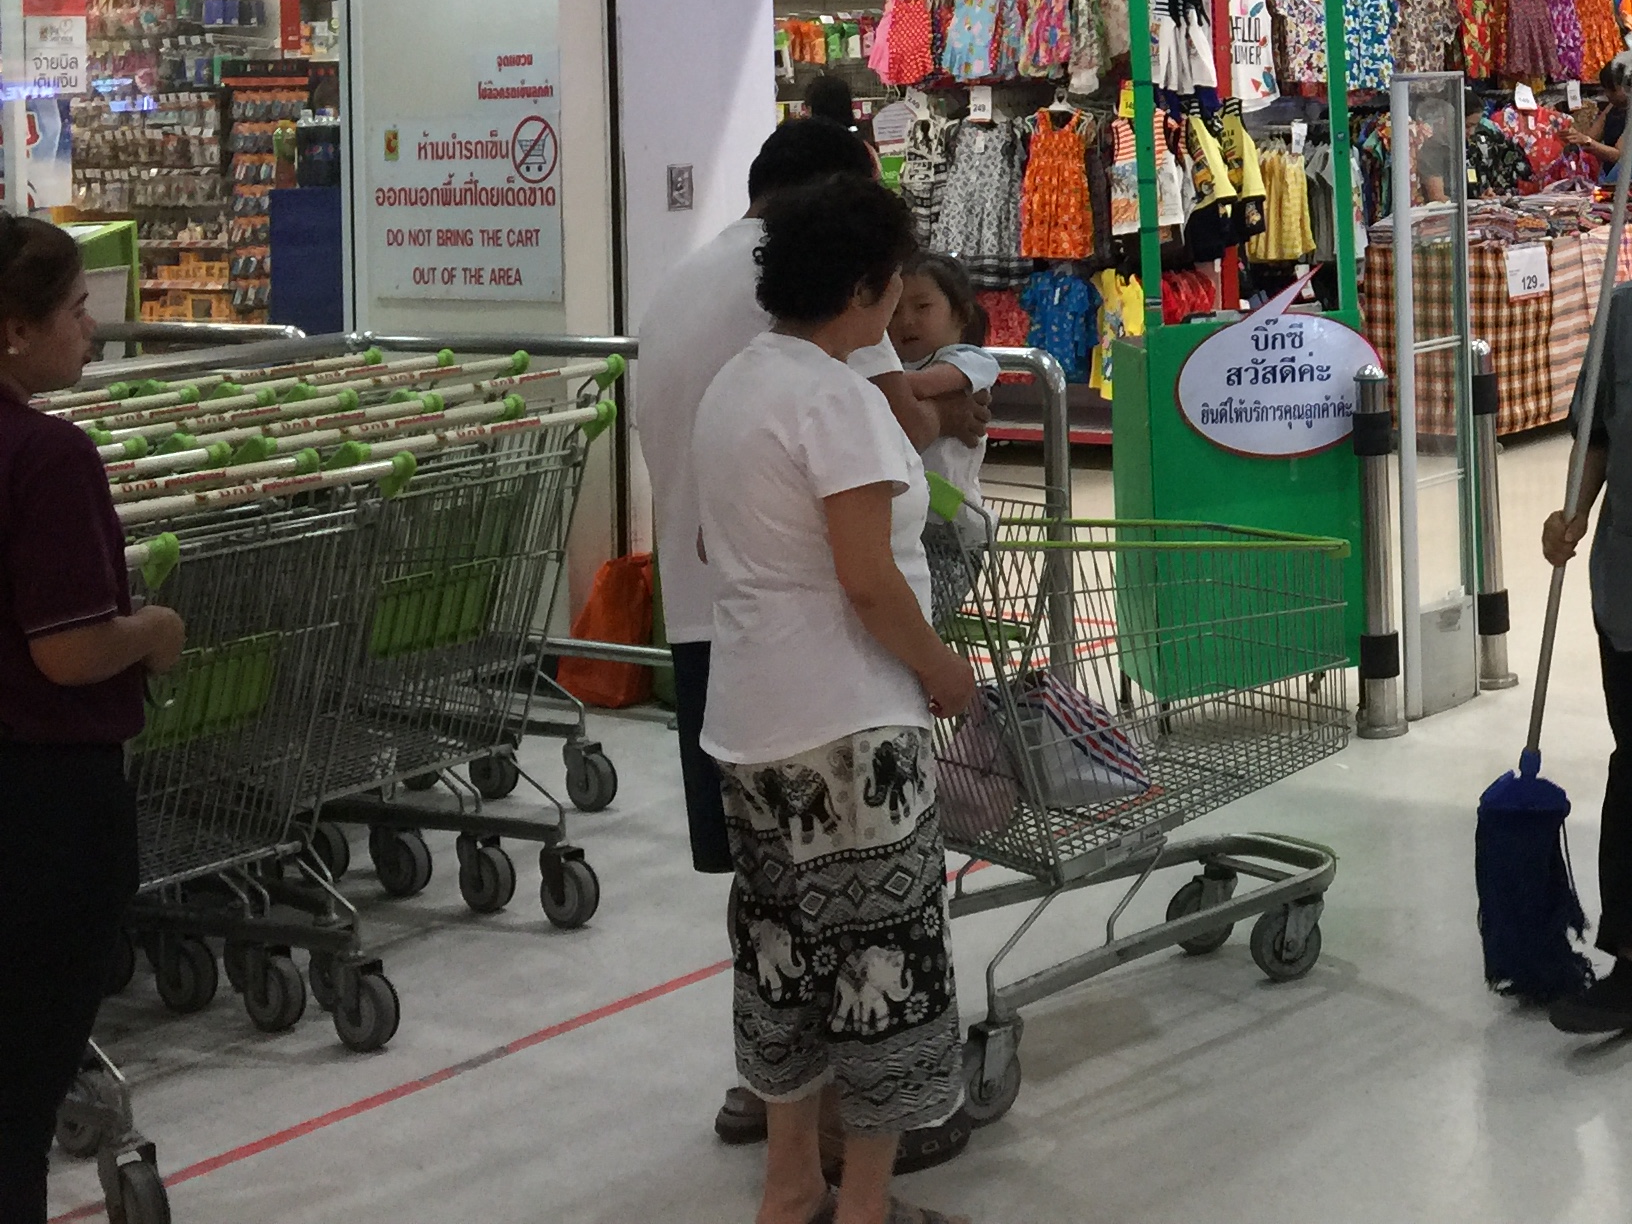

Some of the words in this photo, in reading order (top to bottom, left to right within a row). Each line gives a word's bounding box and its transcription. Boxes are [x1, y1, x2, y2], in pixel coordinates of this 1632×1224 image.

[33, 52, 79, 71] จ่ายบิล
[417, 129, 510, 161] ห้ามนำรถเข็น
[375, 172, 556, 207] ออกนอกพื้นที่โดยเด็ดขาด
[386, 228, 405, 247] DO
[408, 228, 433, 247] NOT
[436, 228, 474, 247] BRING
[479, 228, 502, 247] THE
[506, 228, 541, 247] CART
[412, 266, 437, 285] OUT
[441, 267, 457, 285] OF
[461, 267, 485, 285] THE
[489, 267, 523, 286] AREA
[1521, 274, 1538, 291] 129
[1250, 317, 1305, 352] บิ๊กซี
[1226, 351, 1332, 387] สวัสดีค่ะ
[1200, 394, 1353, 430] ยินดีให้บริการคุณลูกค้าค่ะ
